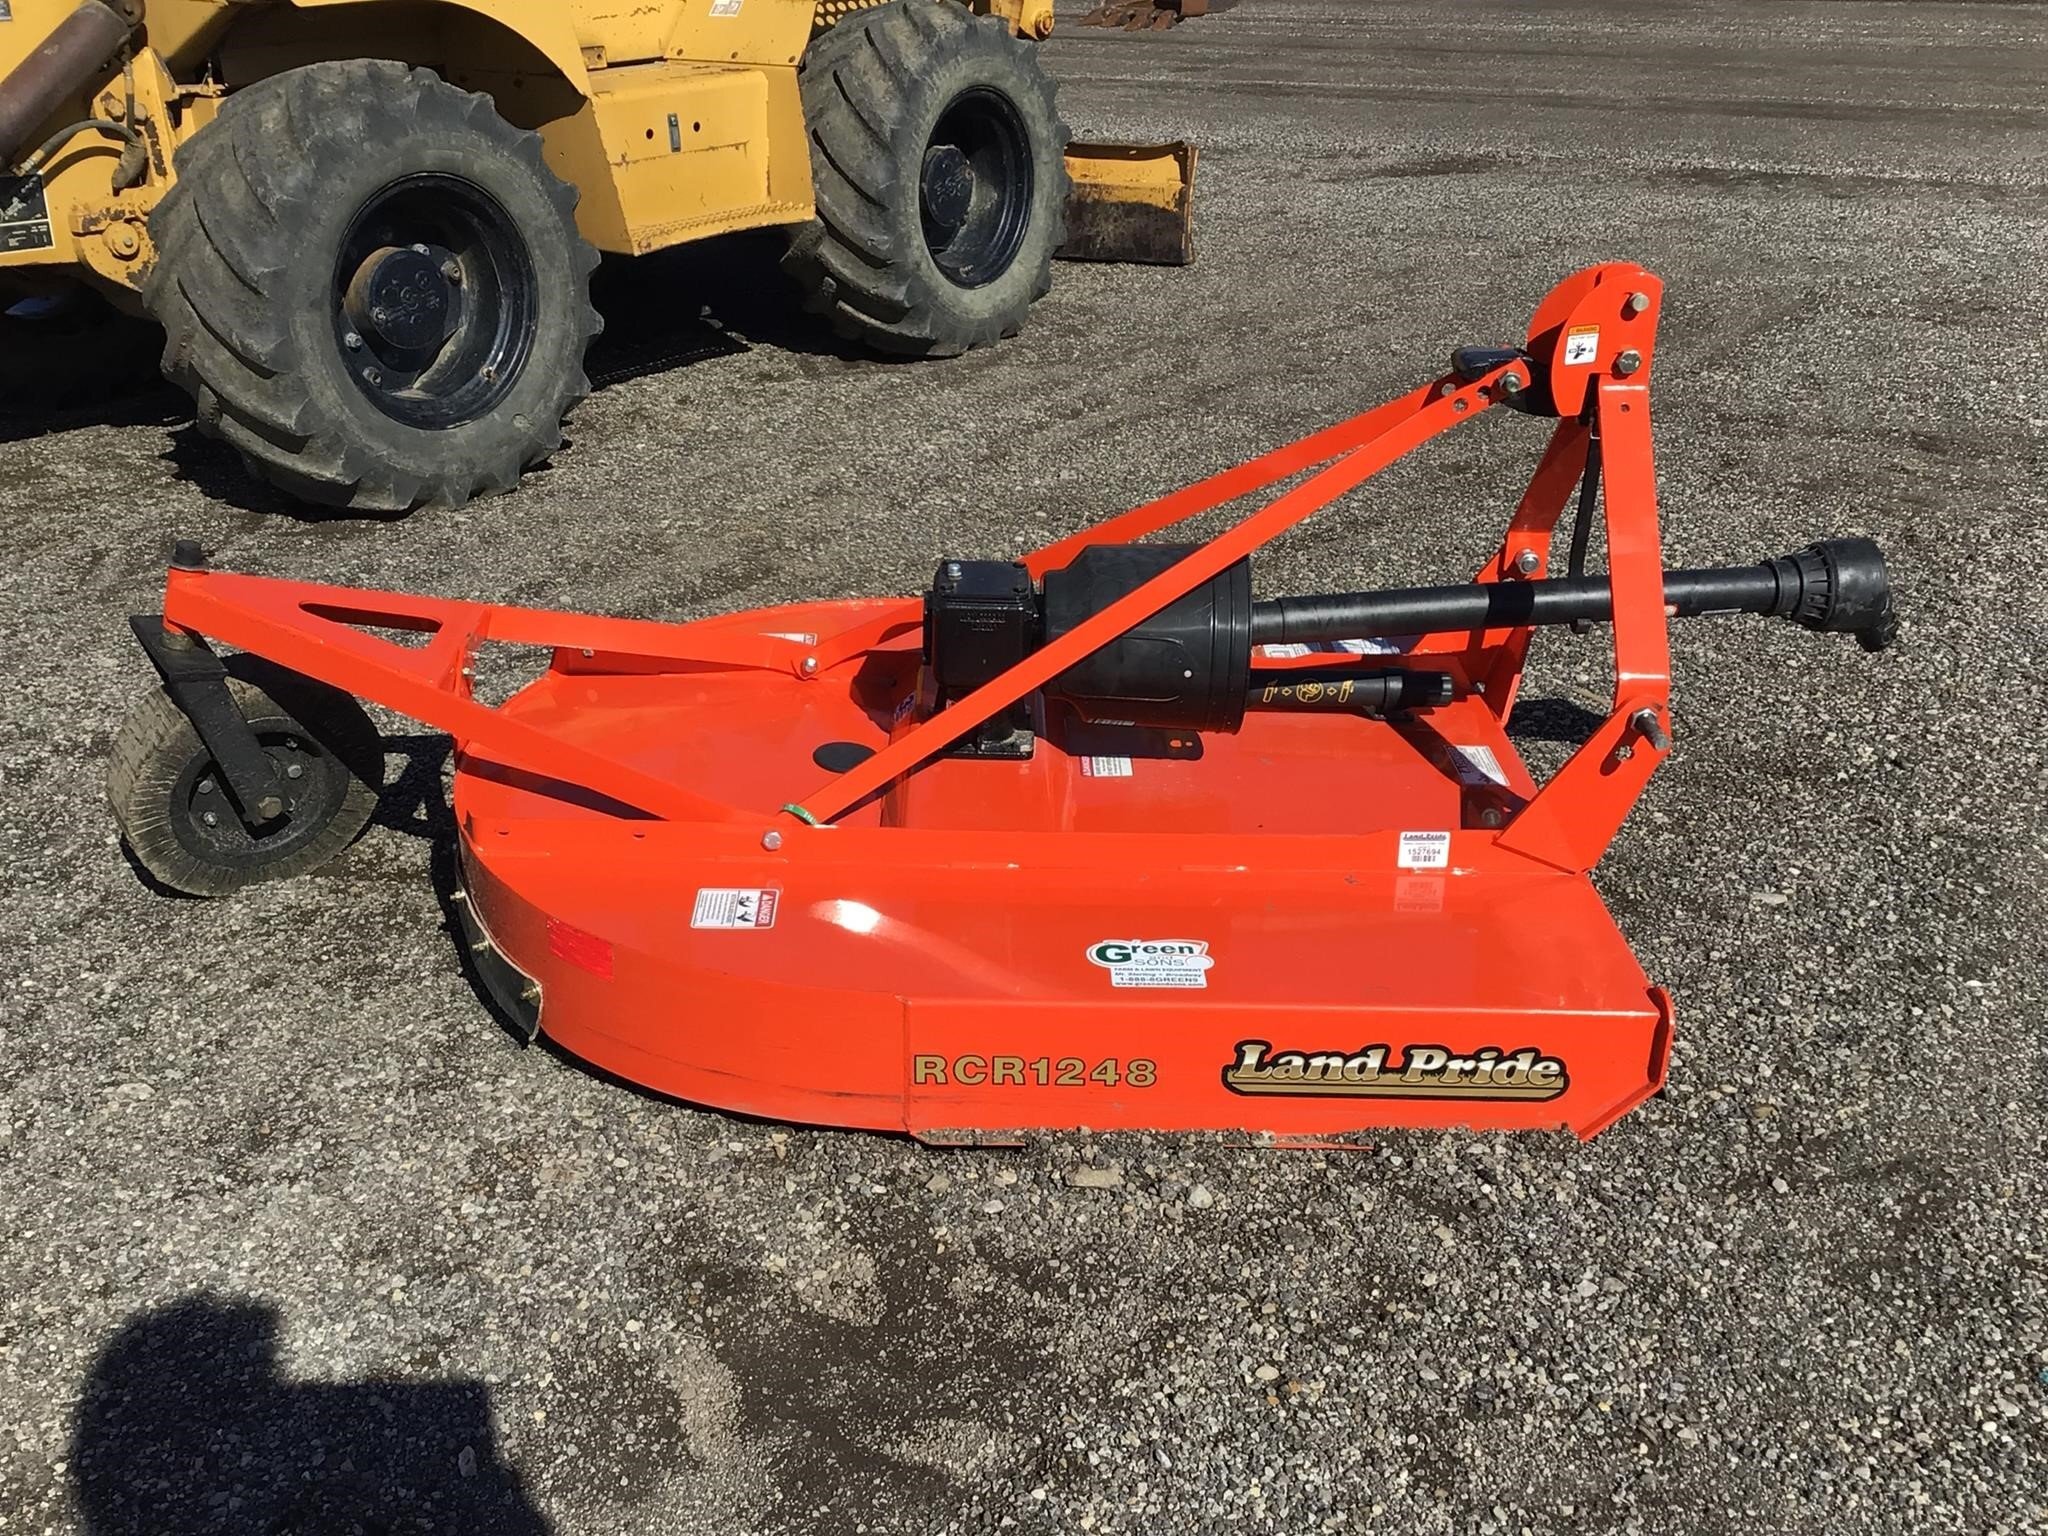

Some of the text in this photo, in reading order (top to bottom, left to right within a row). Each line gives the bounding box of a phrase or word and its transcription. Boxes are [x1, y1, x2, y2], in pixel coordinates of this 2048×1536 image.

[758, 901, 773, 924] DANGER
[1095, 944, 1194, 963] Green
[1134, 959, 1185, 967] SONS
[914, 1055, 1157, 1087] RCR1248
[1232, 1044, 1561, 1086] Land Pride
